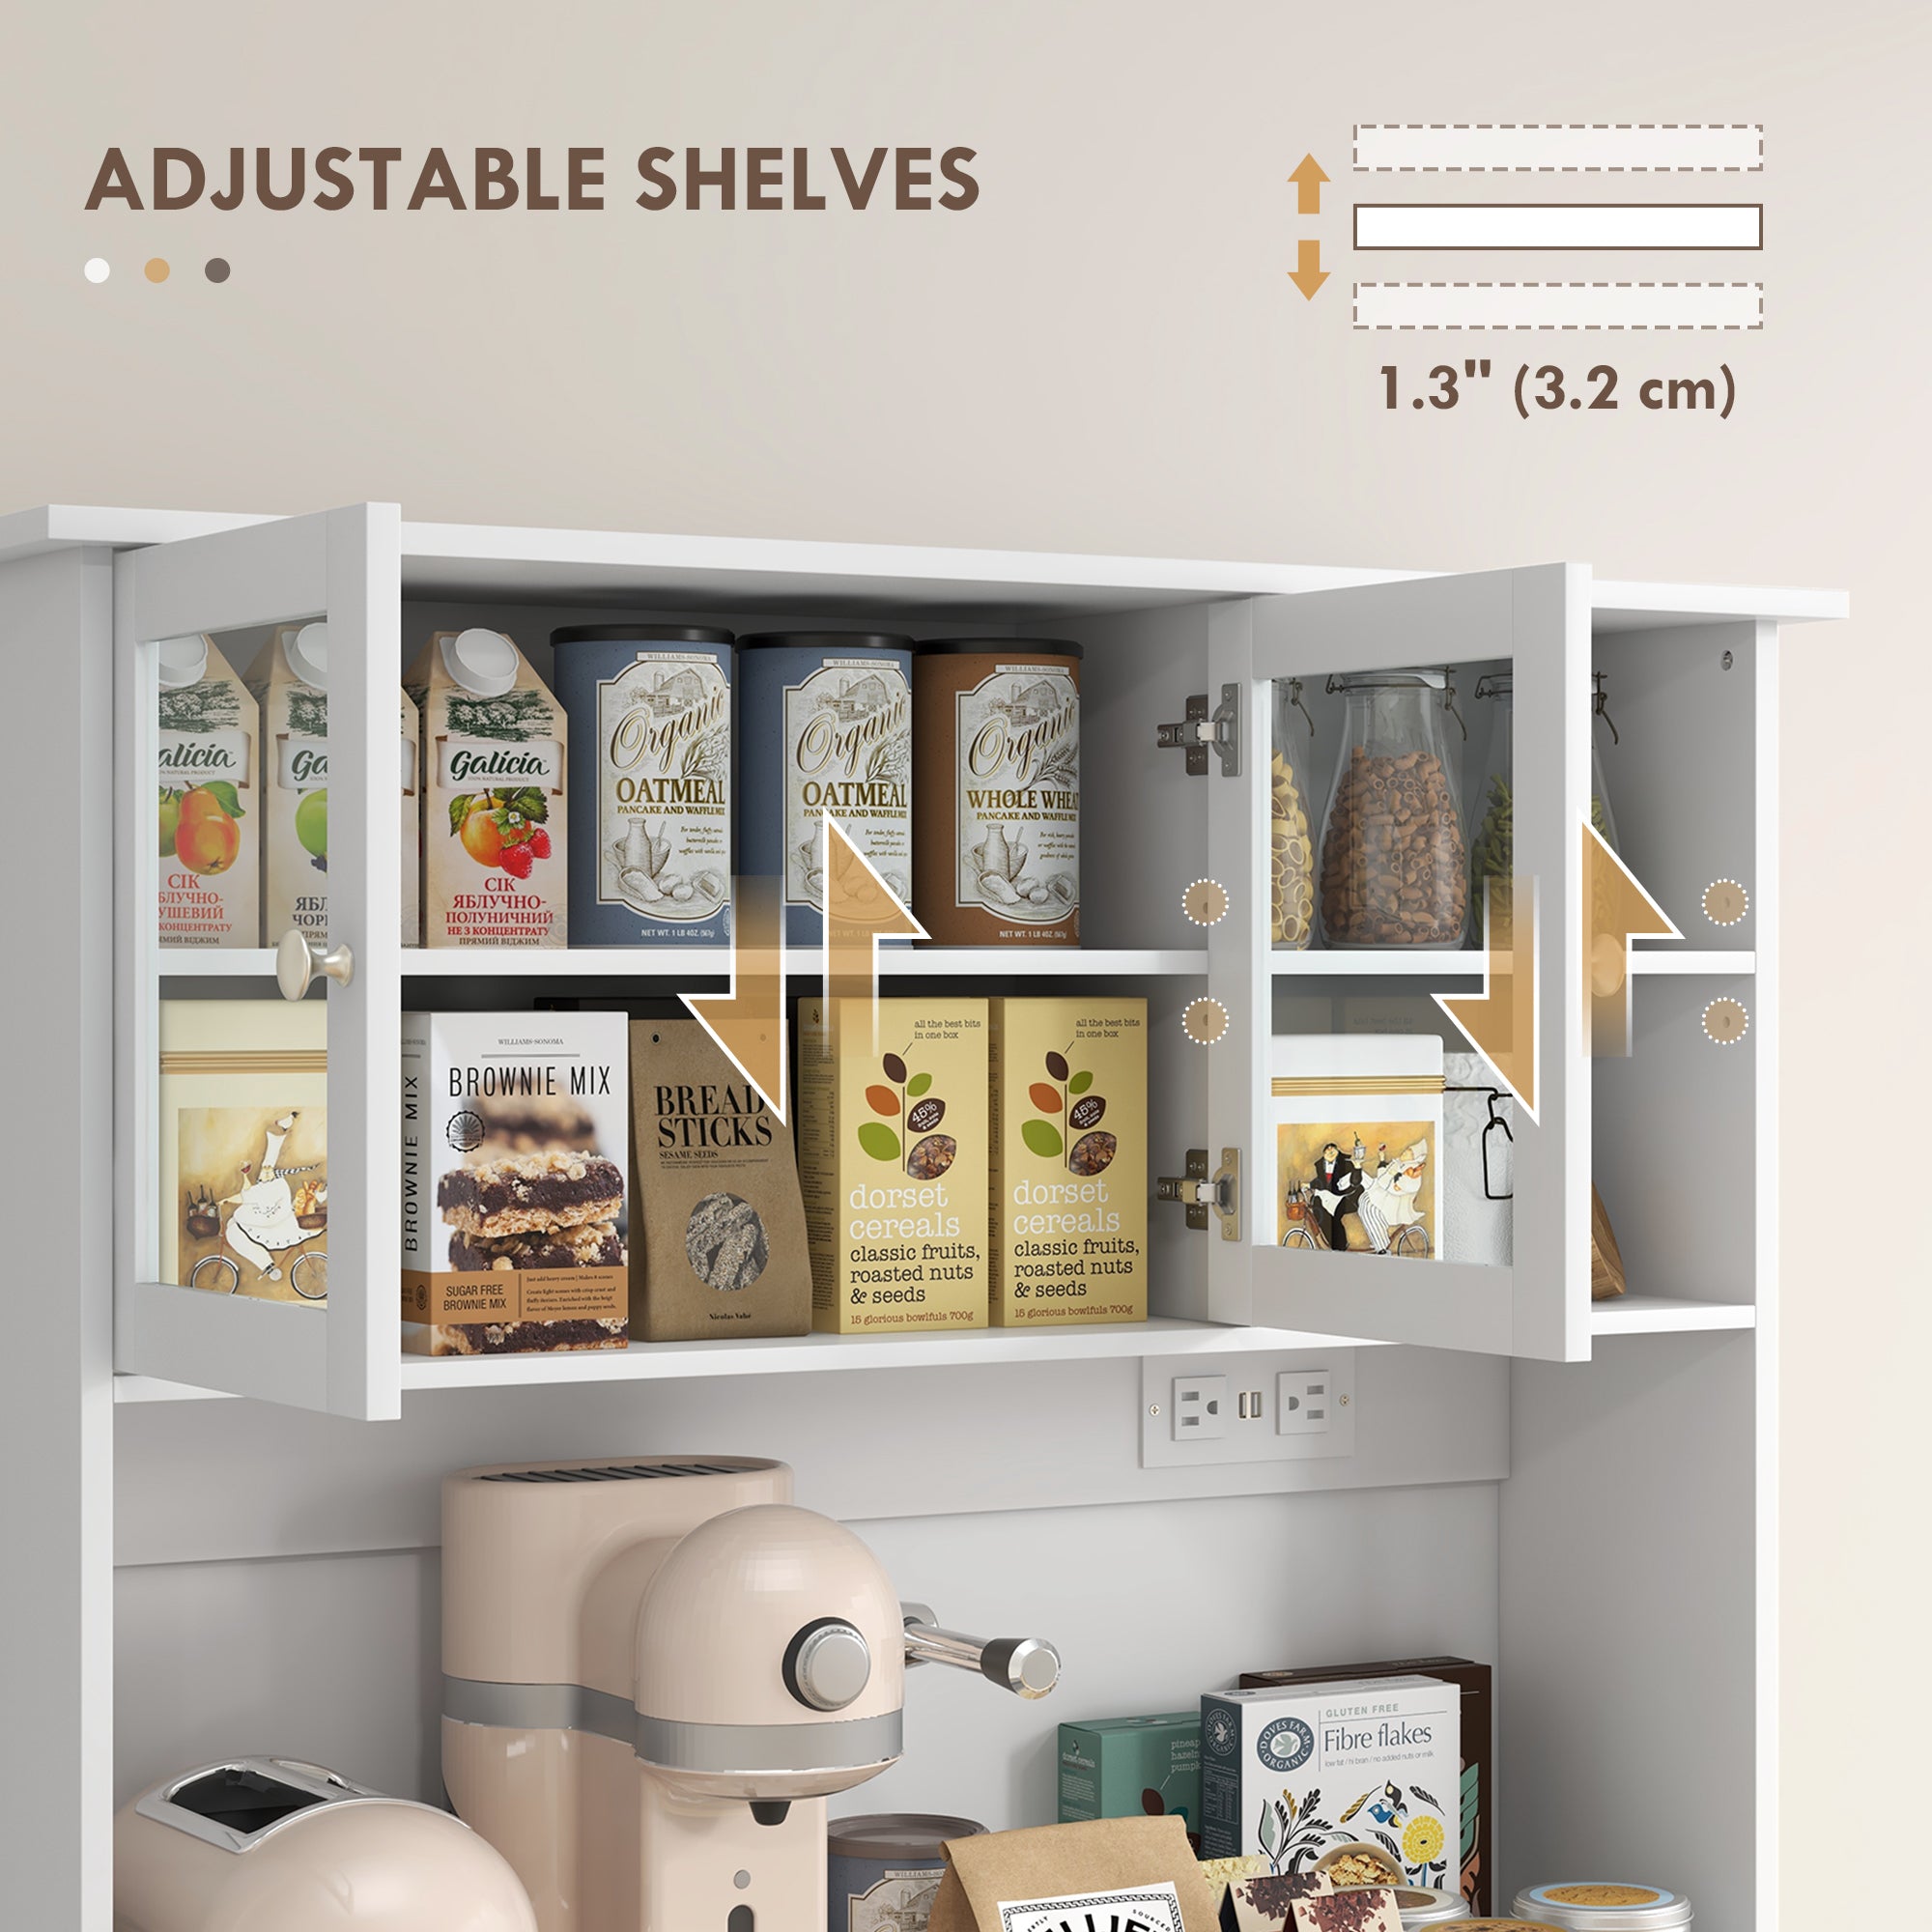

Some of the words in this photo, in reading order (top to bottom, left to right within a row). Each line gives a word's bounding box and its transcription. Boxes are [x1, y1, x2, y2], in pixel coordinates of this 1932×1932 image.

[611, 686, 724, 774] Organic
[796, 692, 905, 778] Organic
[969, 696, 1076, 781] Organic
[450, 750, 550, 781] Galicia
[616, 777, 725, 805] OATMEAL
[802, 781, 907, 808] OATMEAL
[966, 789, 1037, 809] WHOLE
[617, 806, 662, 814] PANCAKE
[664, 806, 684, 815] AND
[804, 809, 847, 817] PANAKE
[848, 810, 868, 818] AND
[167, 873, 201, 889] СІК
[484, 877, 516, 892] СІК
[453, 895, 547, 909] ЯБЛУЧНО-
[445, 910, 554, 924] ПОЛУНИЧНИЙ
[447, 926, 463, 936] НЕ
[472, 926, 550, 937] КОНЦЕНТРАТУ
[459, 936, 498, 946] ПРЯМИЙ
[501, 938, 540, 947] ВІДЖИМ
[964, 1019, 980, 1028] bits
[1123, 1018, 1140, 1027] bits
[914, 1031, 923, 1039] in
[943, 1031, 959, 1039] box
[1076, 1030, 1085, 1038] in
[1103, 1029, 1119, 1038] box
[449, 1066, 556, 1096] BROWNIE
[571, 1065, 611, 1095] MIX
[405, 1076, 418, 1120] MIX
[653, 1084, 765, 1116] BREAD
[658, 1116, 773, 1149] STICKS
[659, 1151, 692, 1159] SESAME
[694, 1150, 719, 1158] SEEDS
[405, 1135, 418, 1252] BROWNIE
[850, 1182, 949, 1209] dorset
[1013, 1179, 1109, 1206] dorset
[850, 1211, 960, 1239] cereals
[1013, 1208, 1121, 1235] cereals
[850, 1244, 917, 1263] classic
[922, 1242, 980, 1261] fruits,
[1014, 1239, 1078, 1257] classic
[1083, 1237, 1140, 1256] fruits,
[850, 1264, 924, 1283] roasted
[929, 1264, 974, 1281] nuts
[1014, 1260, 1085, 1277] roasted
[1091, 1259, 1133, 1274] nuts
[445, 1285, 478, 1297] SUGAR
[480, 1284, 503, 1295] FREE
[850, 1288, 867, 1304] &
[872, 1286, 925, 1304] seeds
[1014, 1282, 1031, 1298] &
[1036, 1281, 1087, 1297] seeds
[443, 1298, 487, 1311] BROWNIE
[489, 1298, 506, 1309] MIX
[1014, 1309, 1025, 1318] 15
[1027, 1307, 1066, 1319] glorious
[1067, 1305, 1108, 1316] bowlfuls
[1110, 1304, 1133, 1315] 700g
[851, 1315, 862, 1324] 15
[864, 1313, 904, 1326] glorious
[906, 1312, 948, 1322] bowlfuls
[950, 1311, 974, 1321] 700g
[1325, 1706, 1368, 1718] GLUTEN
[1372, 1703, 1400, 1714] FREE
[1260, 1720, 1288, 1748] DOVES
[1289, 1720, 1311, 1745] FARM
[1324, 1726, 1373, 1752] Fibre
[1378, 1721, 1432, 1747] flakes
[1263, 1748, 1309, 1770] ORGANIC
[1132, 1909, 1172, 1932] SOURCED
